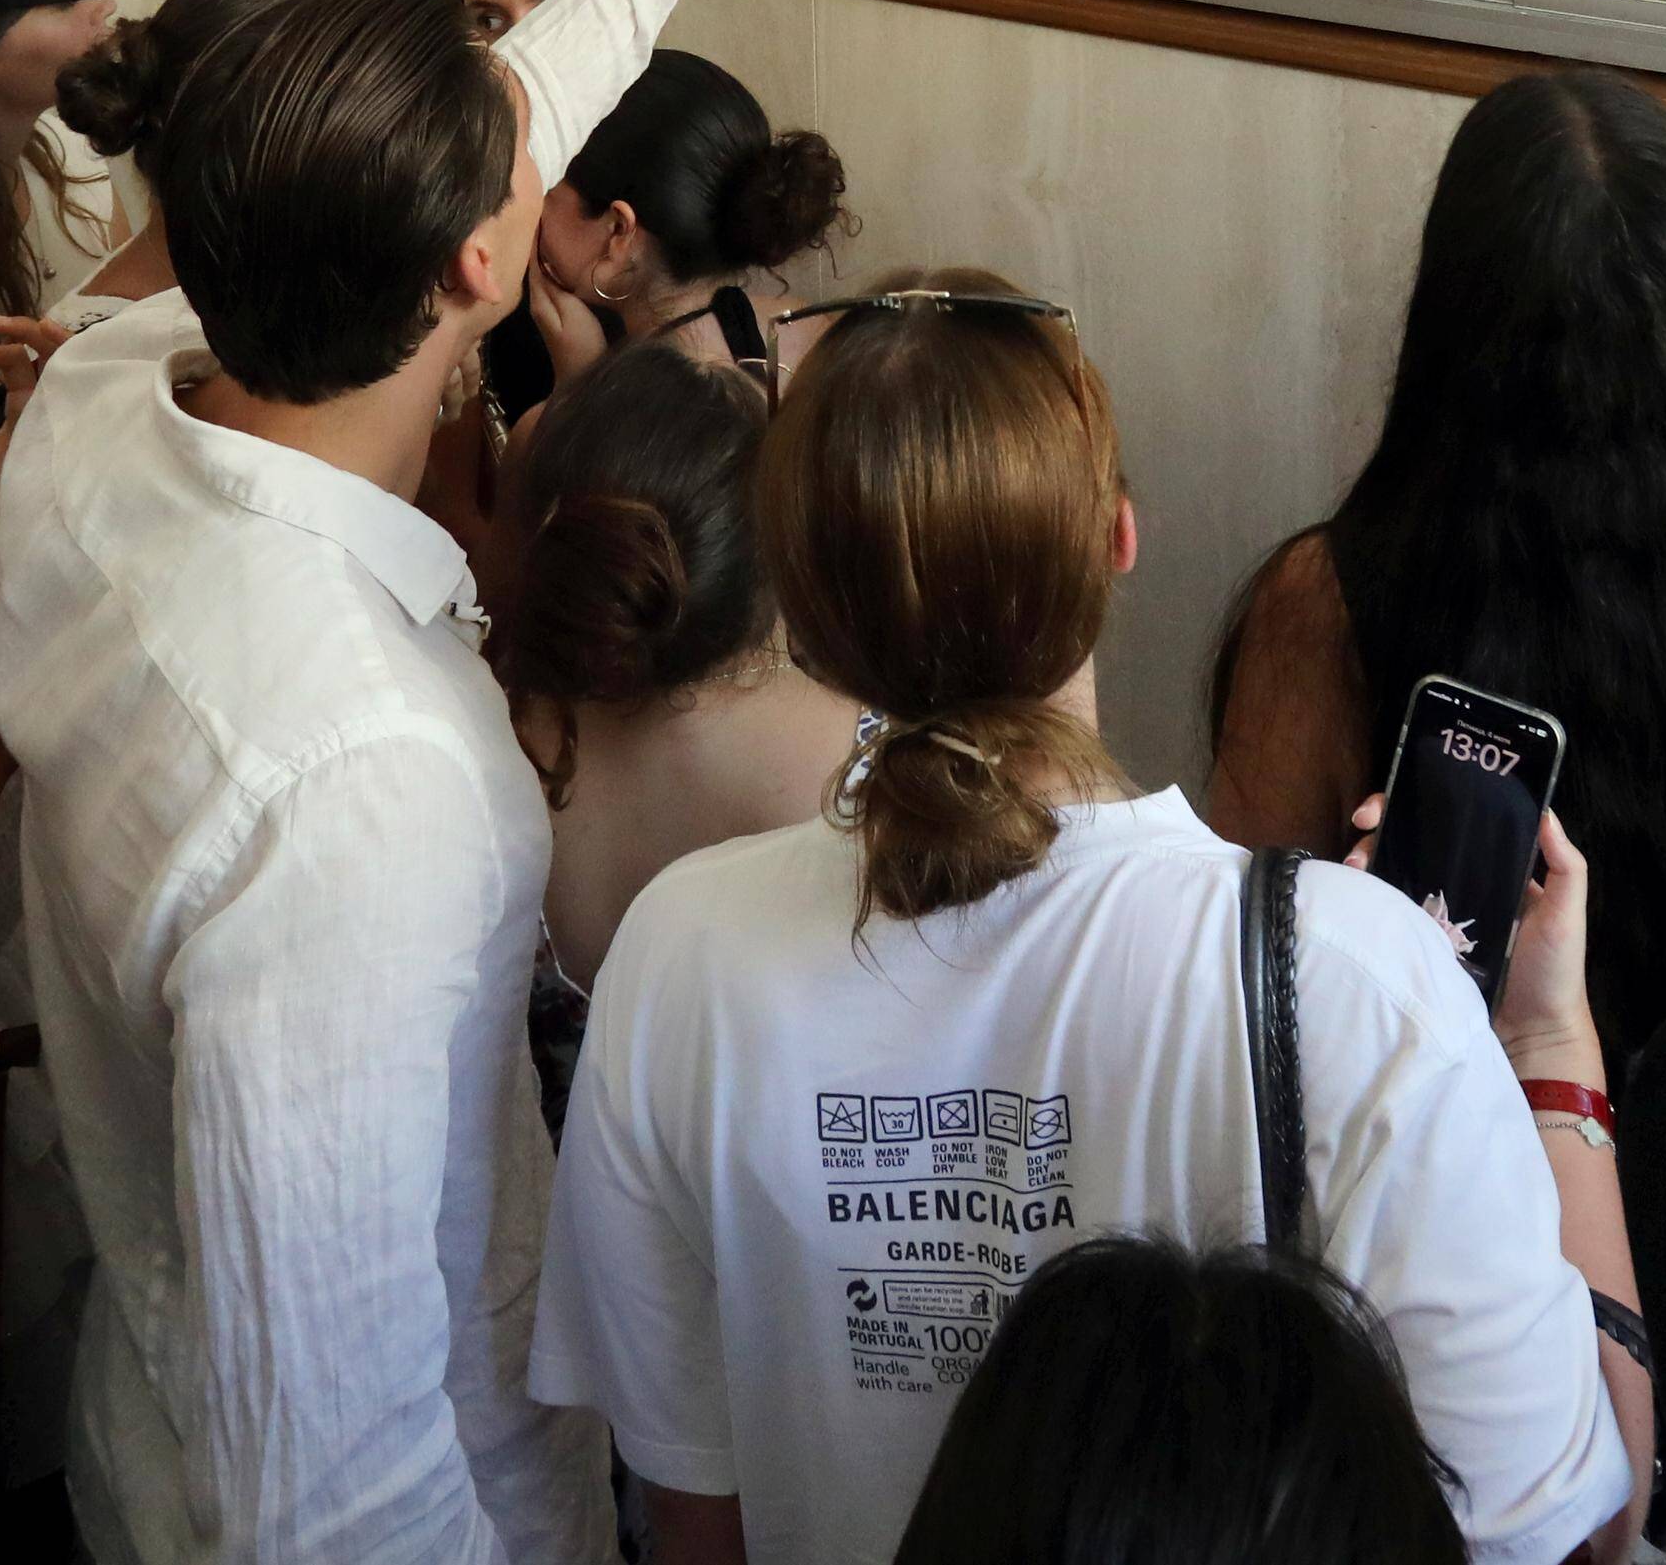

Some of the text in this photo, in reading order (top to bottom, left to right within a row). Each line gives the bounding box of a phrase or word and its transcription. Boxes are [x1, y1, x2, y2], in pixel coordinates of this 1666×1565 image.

[1440, 729, 1520, 776] 13:07
[891, 1120, 903, 1129] 30
[822, 1148, 862, 1157] DO NOT
[875, 1148, 909, 1157] WASH
[932, 1143, 973, 1153] DO NOT
[985, 1145, 1008, 1158] IRON
[823, 1158, 864, 1168] BLEACH
[876, 1158, 905, 1167] COLD
[933, 1154, 977, 1164] TUMBLE
[986, 1156, 1006, 1168] LOW
[1027, 1150, 1068, 1166] DO NOT
[933, 1164, 955, 1174] DRY
[986, 1168, 1008, 1179] HEAT
[1028, 1164, 1049, 1176] DRY
[1029, 1171, 1065, 1187] CLEAN
[828, 1190, 1075, 1235] BALENCIAGA
[887, 1241, 1027, 1274] GARDE-ROBE
[935, 1287, 963, 1295] recycled
[846, 1316, 909, 1334] MADE IN
[849, 1330, 924, 1350] PORTUGAL
[853, 1355, 910, 1376] Handle
[932, 1355, 983, 1371] ORGA
[856, 1376, 933, 1393] with care
